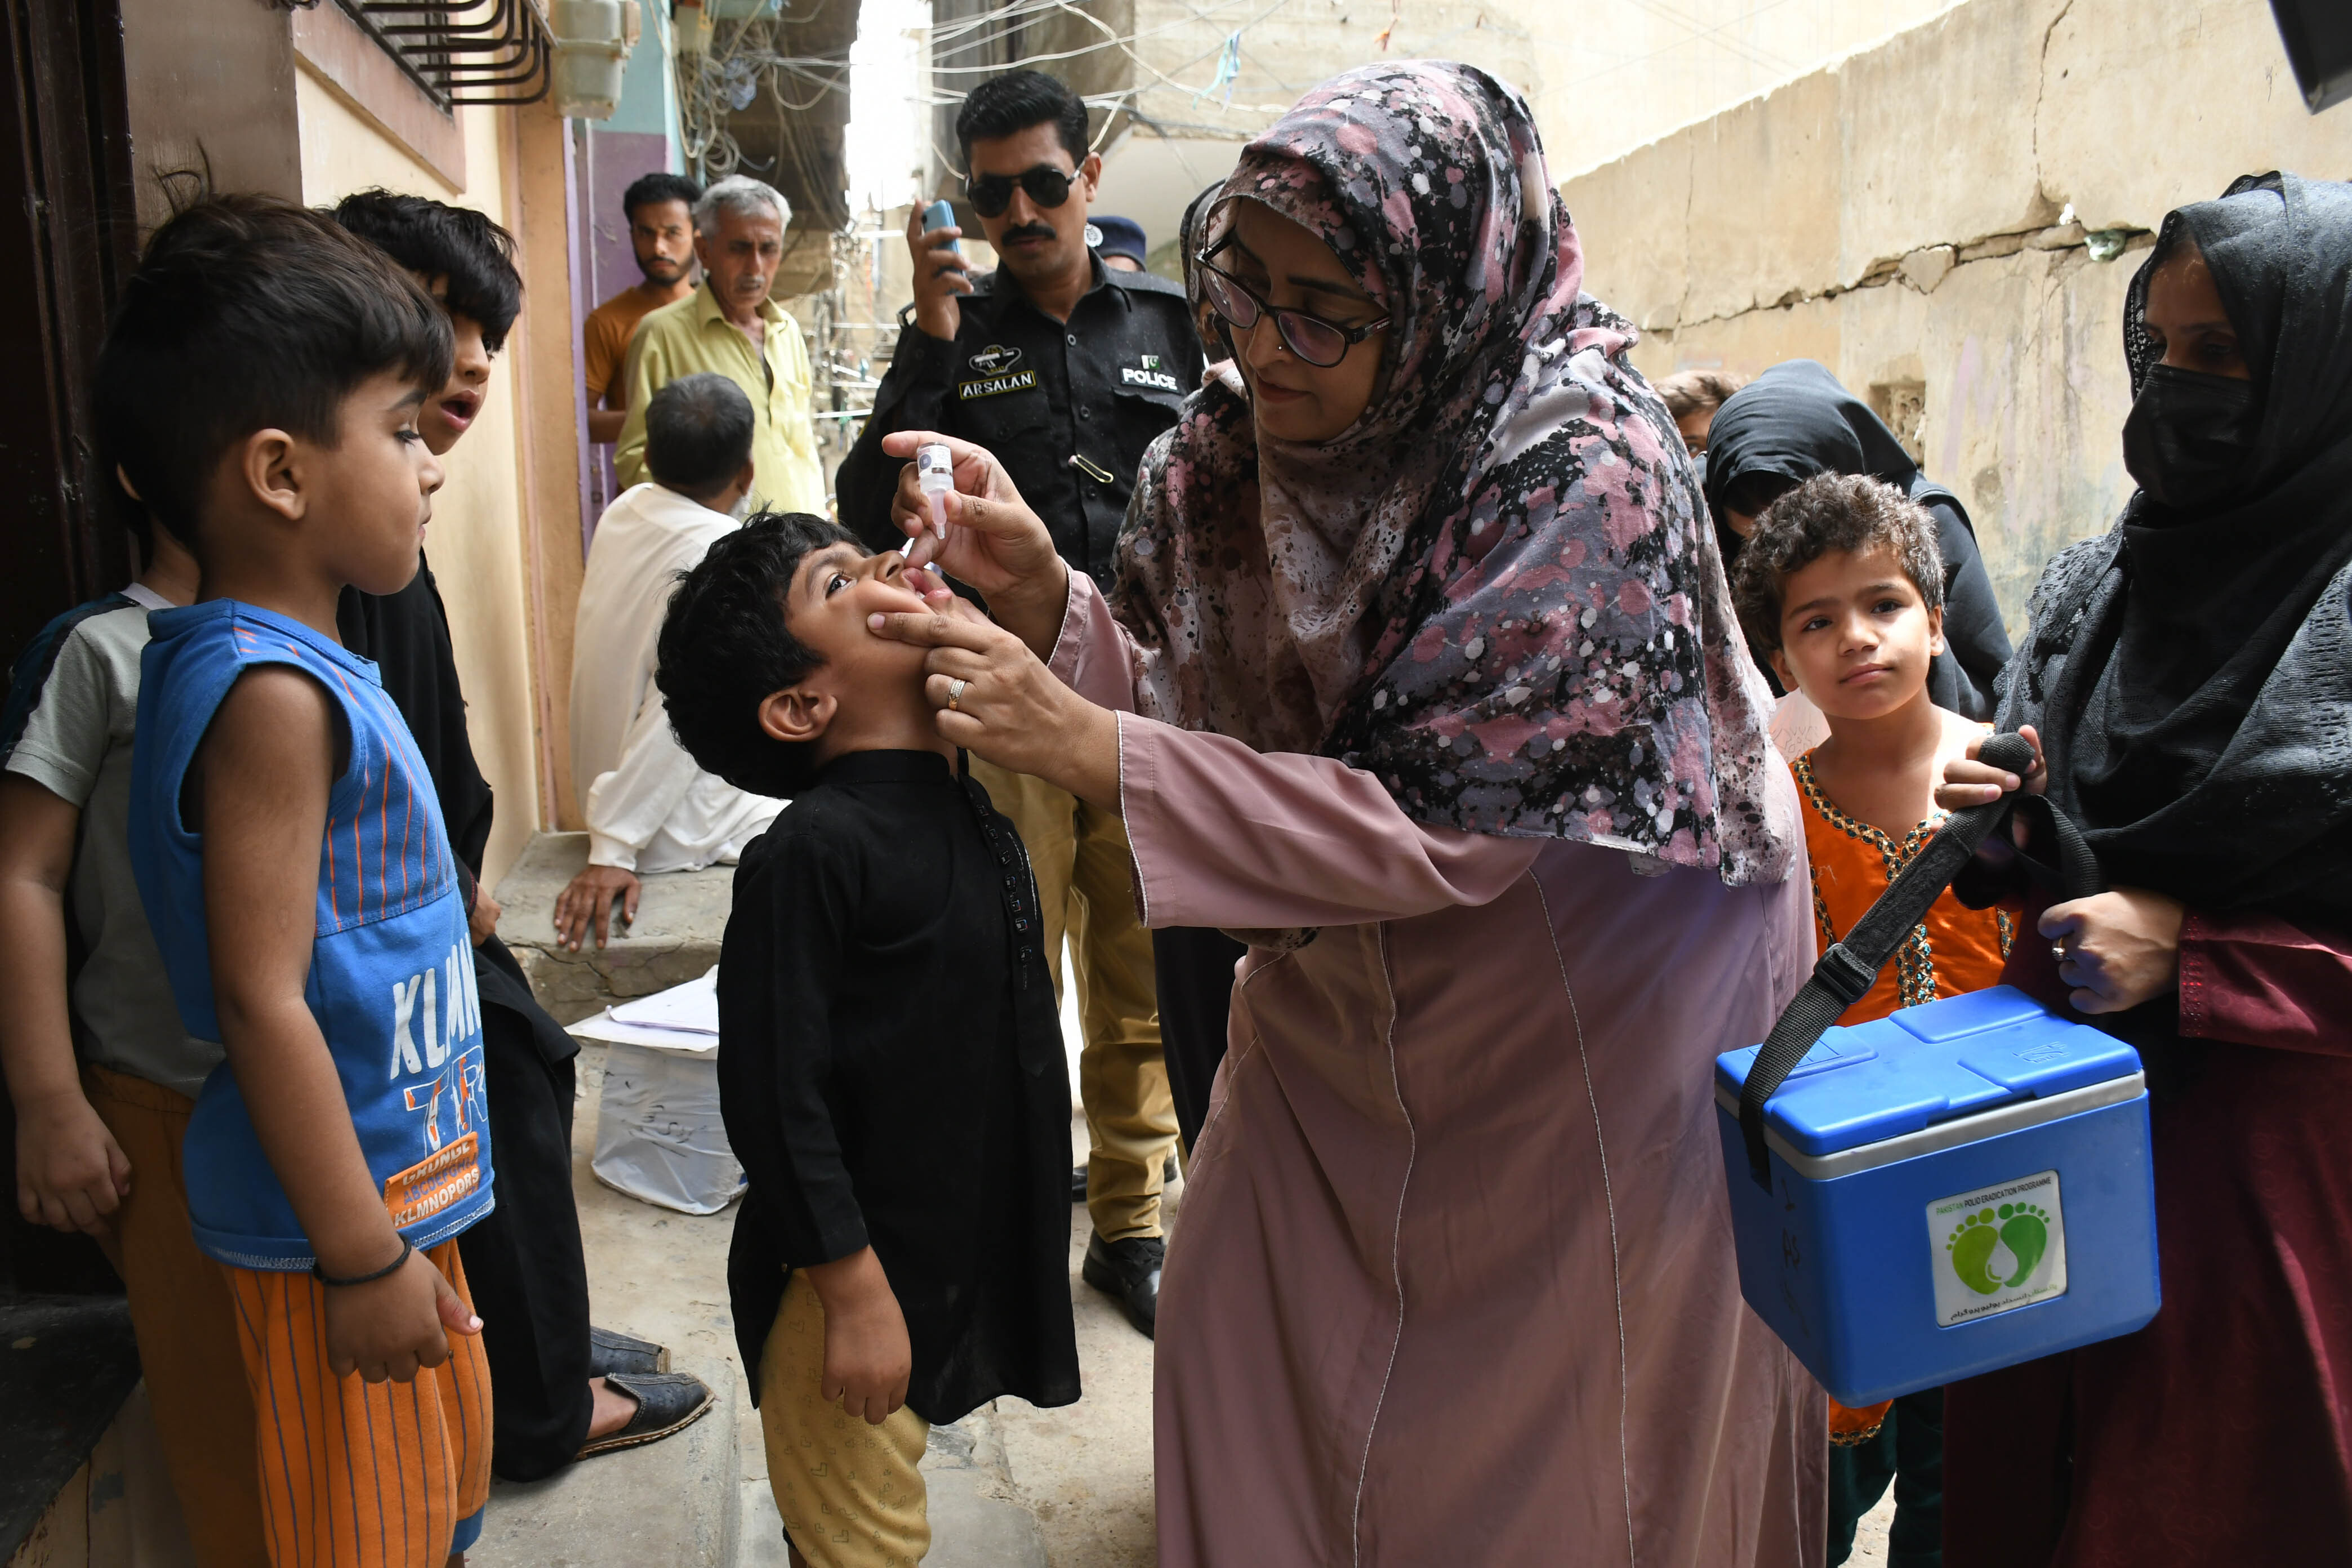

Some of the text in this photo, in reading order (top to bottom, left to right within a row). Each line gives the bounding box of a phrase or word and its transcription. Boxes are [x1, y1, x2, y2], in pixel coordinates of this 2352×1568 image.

[963, 372, 1032, 397] ARSALAN
[1122, 368, 1178, 390] POLICE
[394, 1168, 479, 1227] KLMNOPQRS
[1936, 1177, 2051, 1215] PAKISTAN POLIO ERADICATION PROGRAMME
